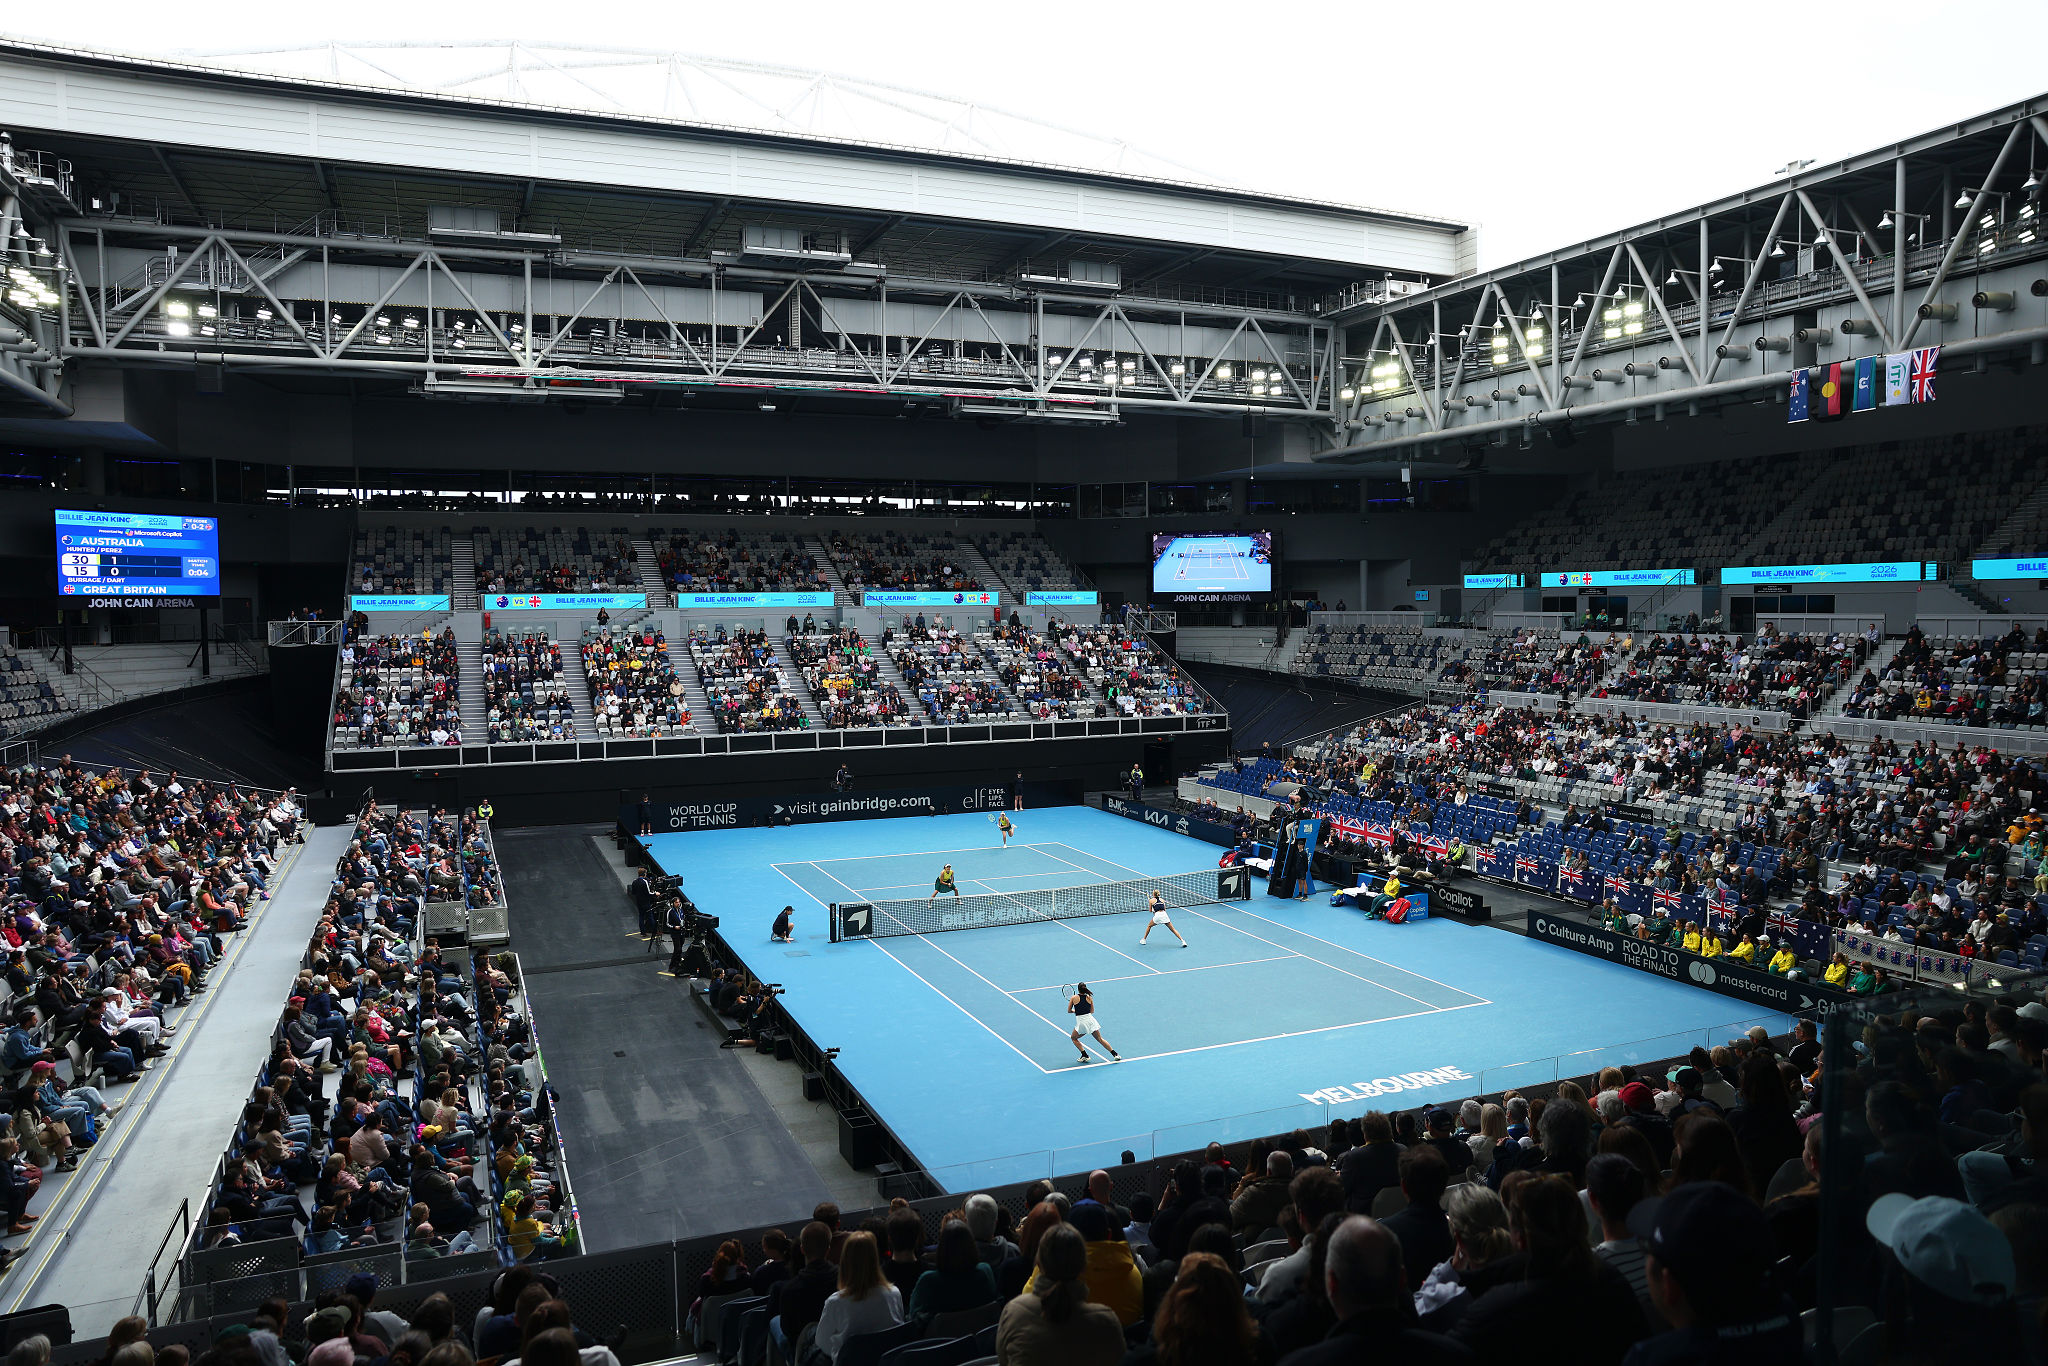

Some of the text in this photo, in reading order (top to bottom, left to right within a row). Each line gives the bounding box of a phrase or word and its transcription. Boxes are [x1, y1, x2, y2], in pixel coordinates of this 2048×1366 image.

[1890, 364, 1901, 387] ITF
[58, 513, 84, 521] BILLIE
[80, 537, 144, 547] AUSTRALIA
[72, 555, 117, 565] 30 1
[74, 566, 120, 576] 15 0
[188, 569, 209, 577] 0:04
[1751, 570, 1773, 578] BILLIE
[1773, 569, 1796, 577] JEAN
[1795, 569, 1814, 577] KING
[1871, 565, 1898, 574] 2026
[2016, 562, 2047, 572] BILLIE
[1630, 573, 1647, 581] JEAN
[1647, 572, 1662, 580] KING
[82, 585, 167, 594] GREAT BRITAIN
[88, 598, 195, 608] JOHN CAIN ARENA
[1220, 594, 1252, 602] ARENA
[1197, 720, 1211, 729] ITF
[669, 803, 737, 816] WORLD CUP
[788, 797, 931, 816] visit gainbridge.com
[670, 813, 737, 828] OF TENNIS
[1144, 809, 1169, 826] KIA
[1438, 888, 1474, 908] Copilot
[1548, 923, 1614, 954] Culture Amp
[1622, 939, 1679, 966] ROAD TO
[1622, 952, 1678, 977] THE FINALS
[1720, 974, 1788, 1001] mastercard
[1297, 1065, 1474, 1106] MELBOURNE
